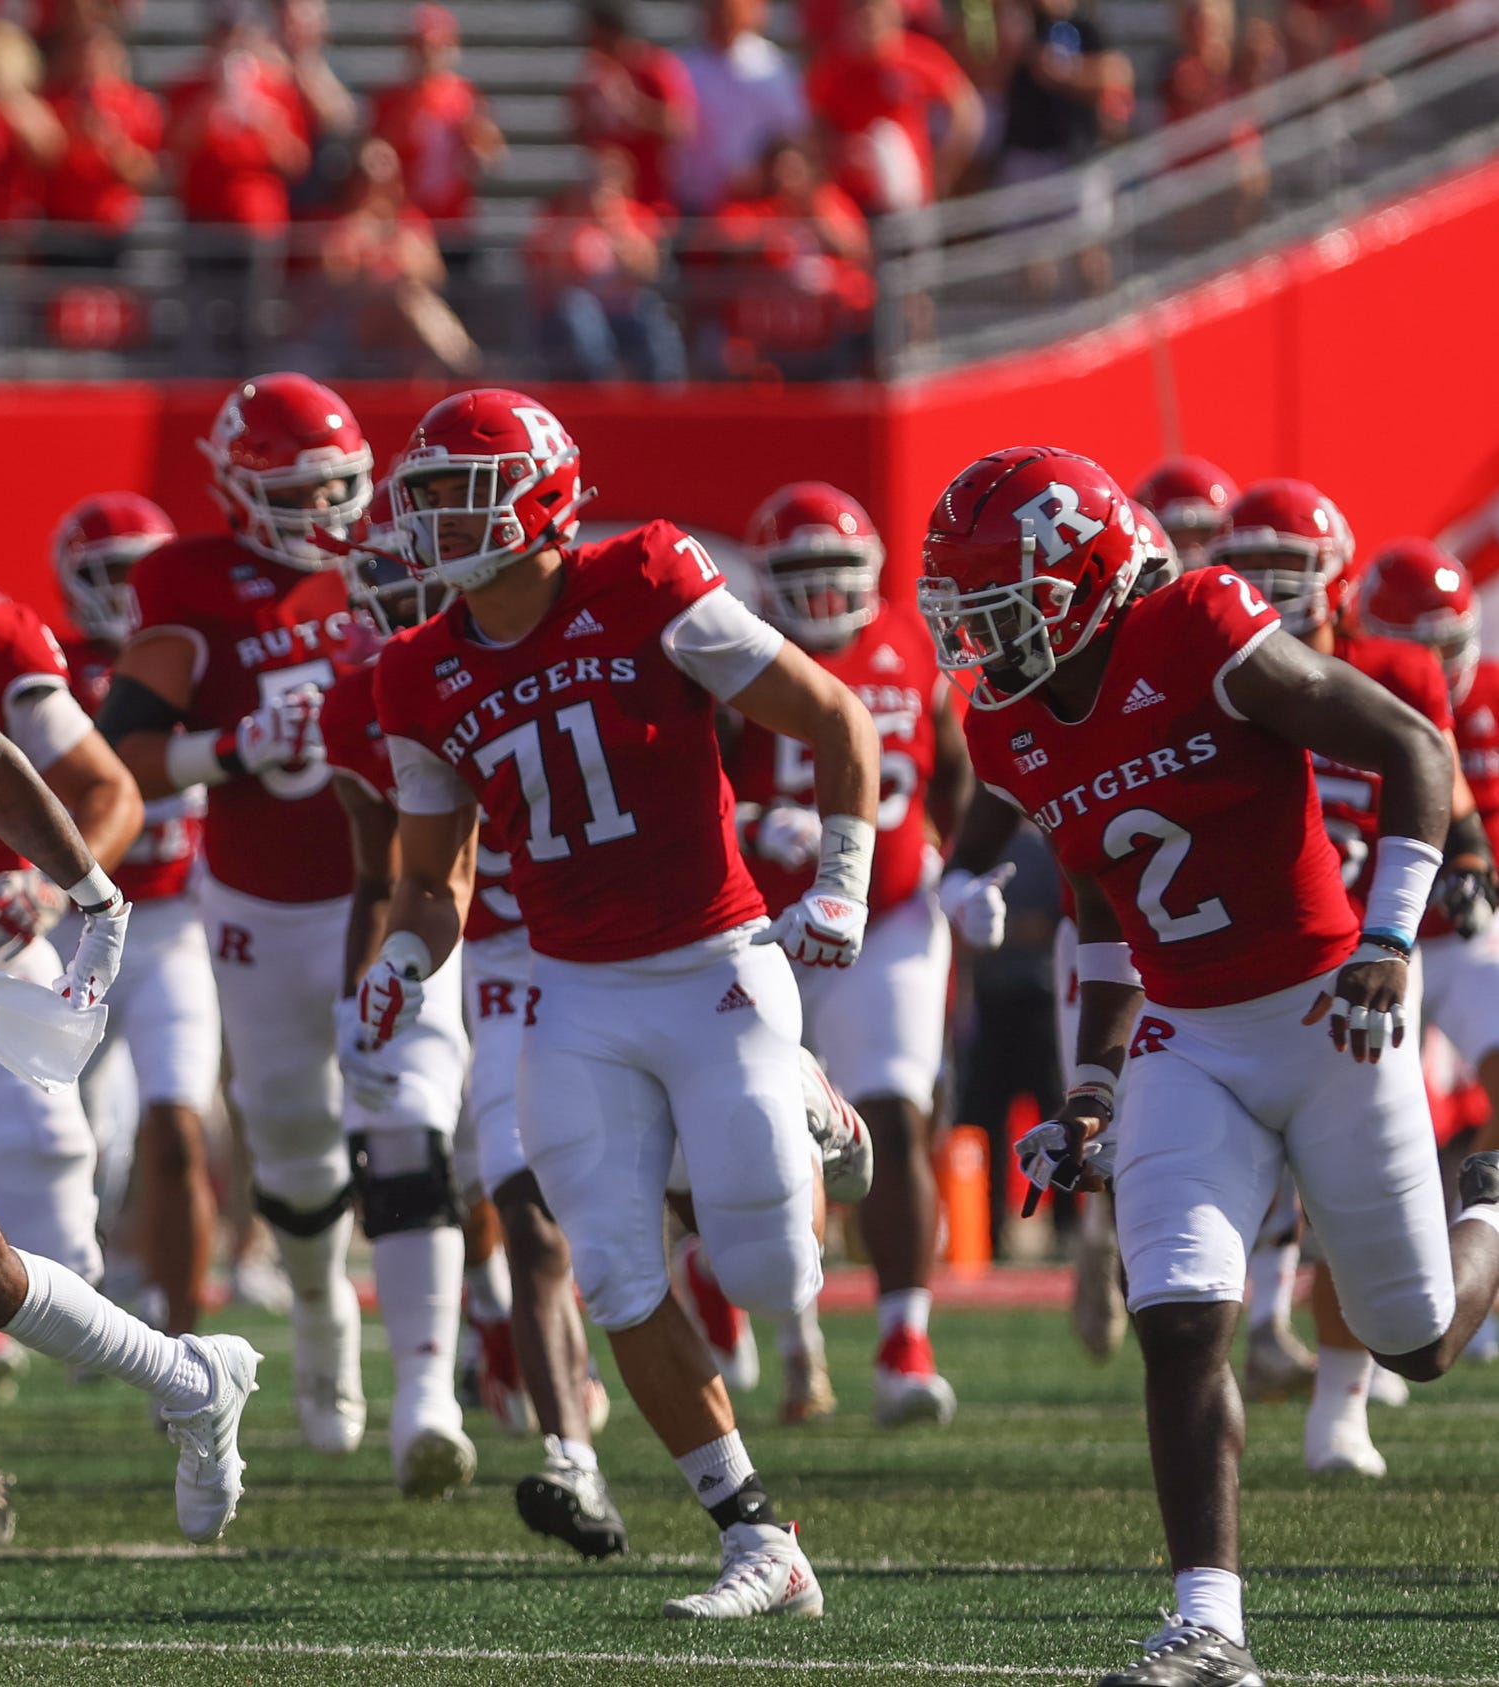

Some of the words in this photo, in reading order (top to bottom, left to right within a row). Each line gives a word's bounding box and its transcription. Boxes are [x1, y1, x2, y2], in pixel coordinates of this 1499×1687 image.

[511, 406, 574, 463] R
[1011, 483, 1106, 567] R
[1218, 573, 1269, 618] 2
[236, 609, 376, 668] RUTG
[441, 656, 638, 766] RUTGERS
[1122, 692, 1166, 714] adidas
[1011, 732, 1034, 751] REM
[473, 700, 638, 864] 71
[1034, 732, 1219, 833] RUTGERS
[1103, 807, 1232, 944] 2
[219, 922, 256, 967] R
[479, 979, 516, 1020] R
[1129, 1016, 1176, 1059] R
